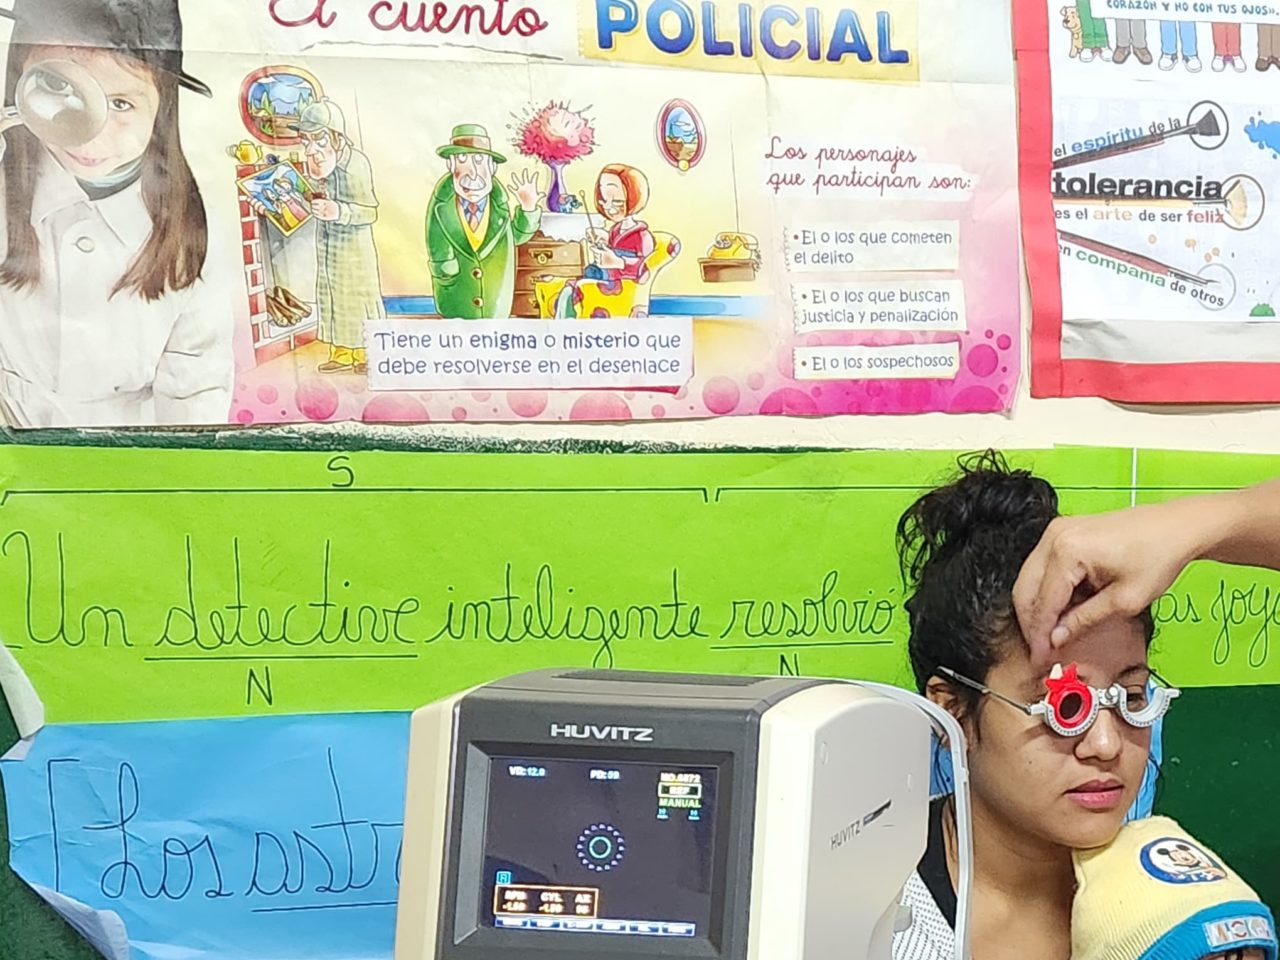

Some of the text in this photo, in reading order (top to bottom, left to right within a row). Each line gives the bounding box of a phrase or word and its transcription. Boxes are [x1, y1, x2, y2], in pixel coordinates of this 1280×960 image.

[1161, 2, 1170, 11] Y
[1174, 2, 1189, 12] NO
[1217, 4, 1237, 14] TUS
[368, 0, 549, 37] cuento
[595, 0, 909, 65] POLICIAL
[1054, 116, 1181, 157] el espíritu de la
[765, 136, 917, 175] Los personajes
[766, 166, 973, 196] que participan son:
[1053, 171, 1223, 200] tolerancia
[1055, 207, 1225, 224] es el arte de ser feliz
[802, 229, 952, 251] El o los que cometen
[793, 249, 854, 265] el delito
[812, 288, 951, 309] El o los que buscan
[1170, 280, 1187, 295] de
[1190, 288, 1225, 307] otros
[801, 306, 959, 326] justicia y penalización
[374, 331, 681, 351] Tiene un enigma o misterio que
[378, 357, 681, 375] debe resolverse en el desenlace
[812, 354, 954, 373] El o los sospechosos
[1, 531, 134, 648] Un
[153, 534, 420, 651] detective
[425, 562, 709, 669] inteligente
[720, 570, 897, 639] resolvió
[1153, 592, 1202, 623] as
[247, 666, 273, 706] N
[550, 724, 655, 741] HUVITZ
[658, 798, 702, 808] MANUAL
[245, 747, 404, 896] astr
[829, 819, 861, 851] HUVITZ
